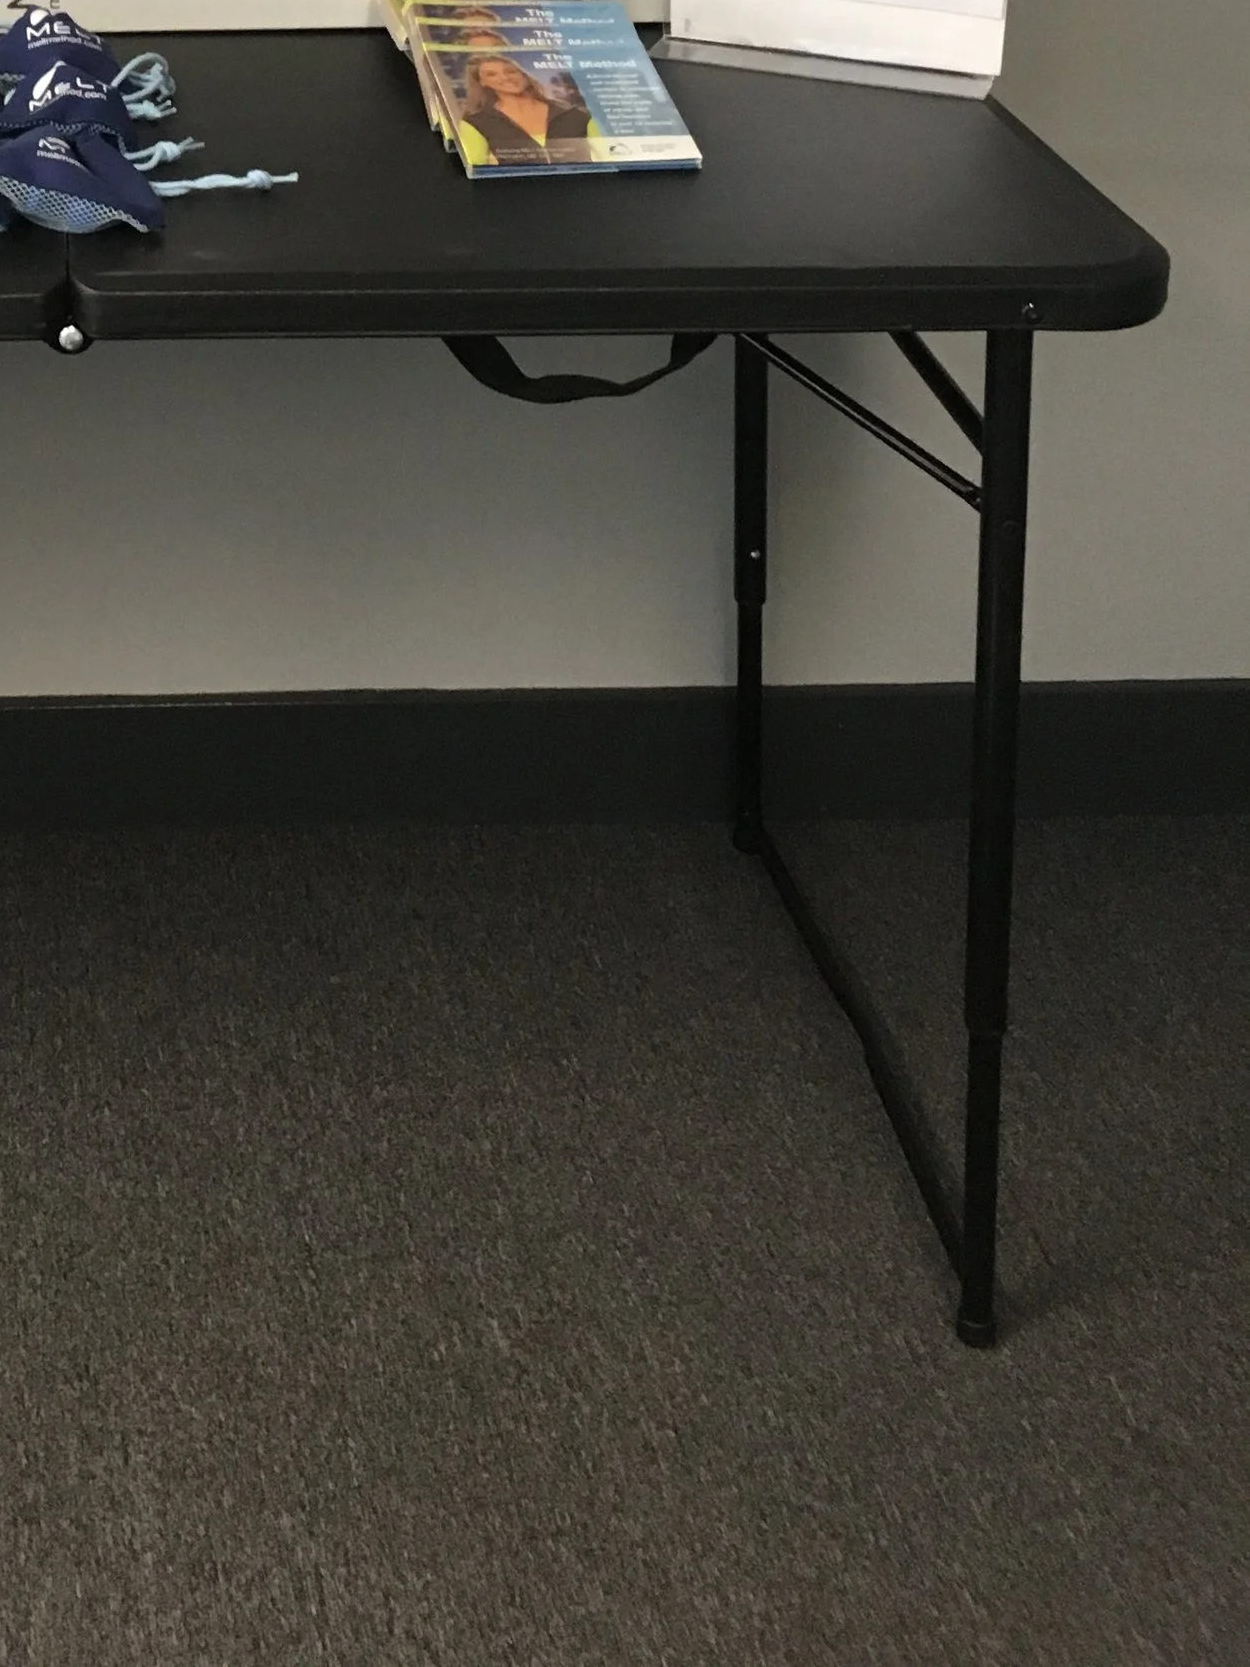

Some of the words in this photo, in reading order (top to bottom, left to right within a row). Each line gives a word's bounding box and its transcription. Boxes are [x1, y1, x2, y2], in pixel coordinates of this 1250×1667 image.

[526, 8, 554, 17] The
[26, 21, 101, 44] MELT
[533, 30, 563, 39] The
[522, 38, 563, 47] MELT
[542, 53, 573, 61] The
[534, 61, 573, 70] MELT
[580, 60, 637, 69] Method
